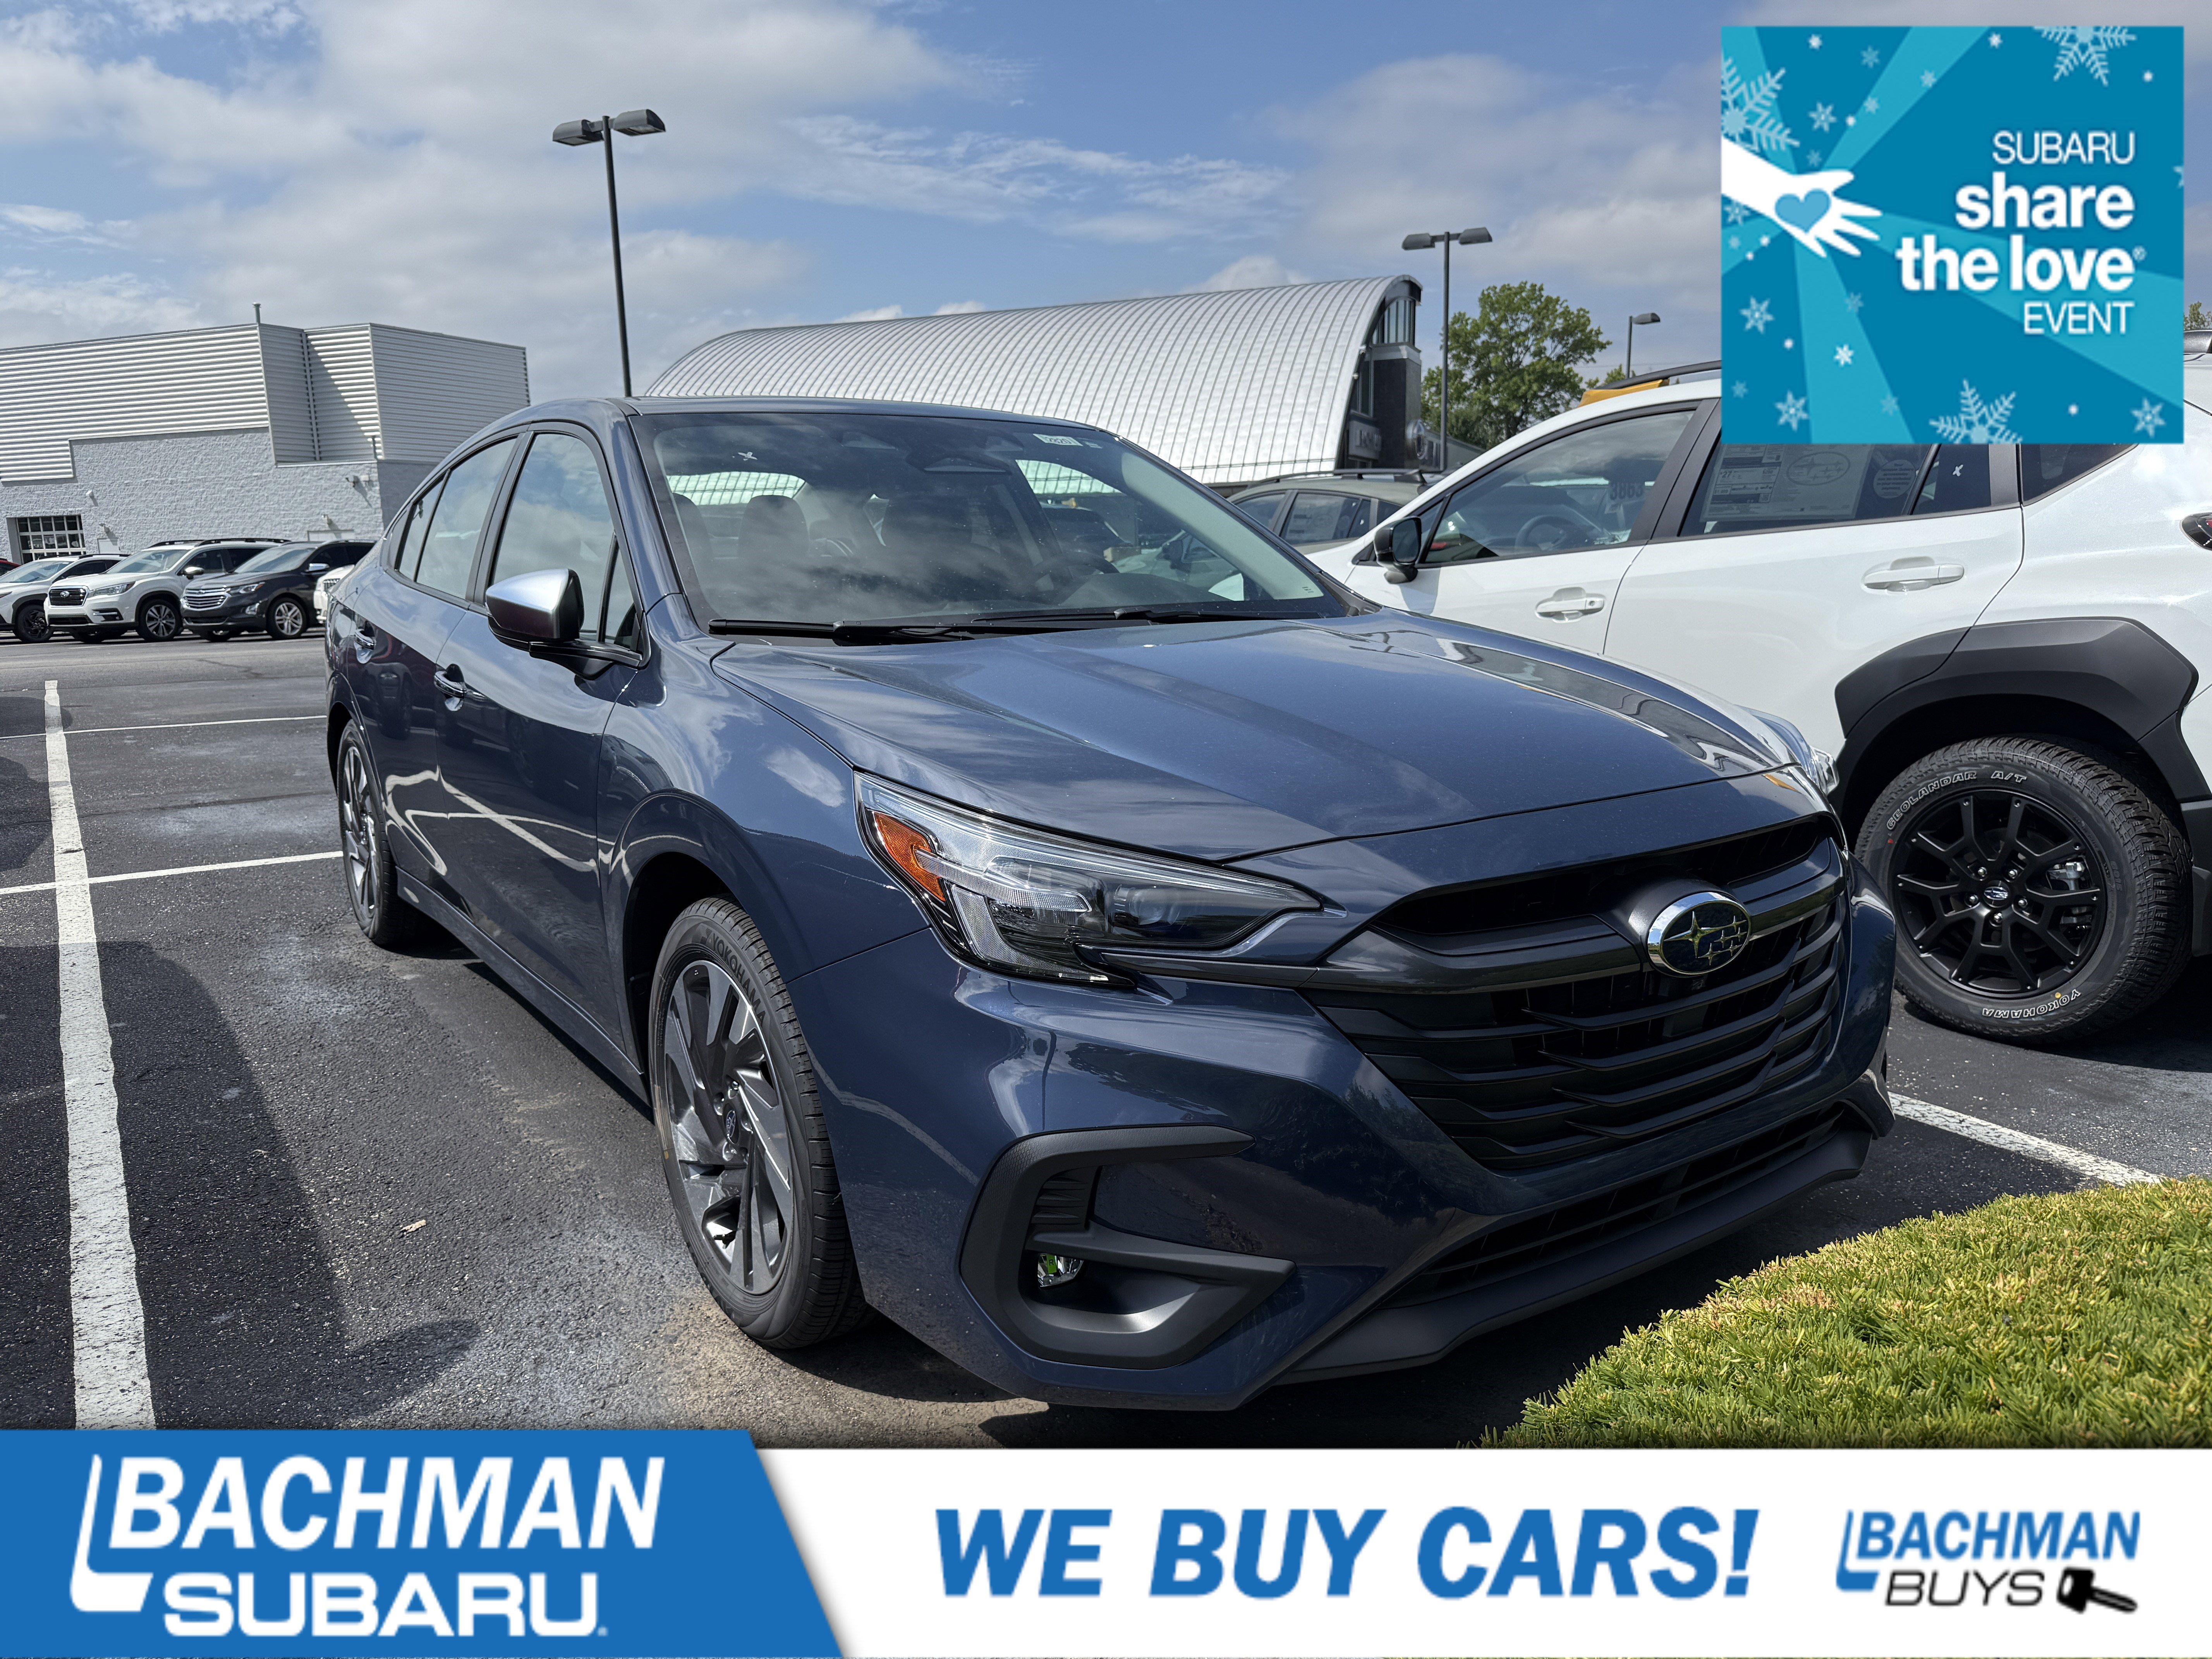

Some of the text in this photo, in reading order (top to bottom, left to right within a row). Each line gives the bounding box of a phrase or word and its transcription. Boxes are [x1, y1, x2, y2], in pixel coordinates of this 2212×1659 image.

[1886, 770, 2027, 831] GEOLANDAR A/T
[713, 933, 766, 1027] YOKOHAMA
[1982, 989, 2081, 1019] YOKOHAMA
